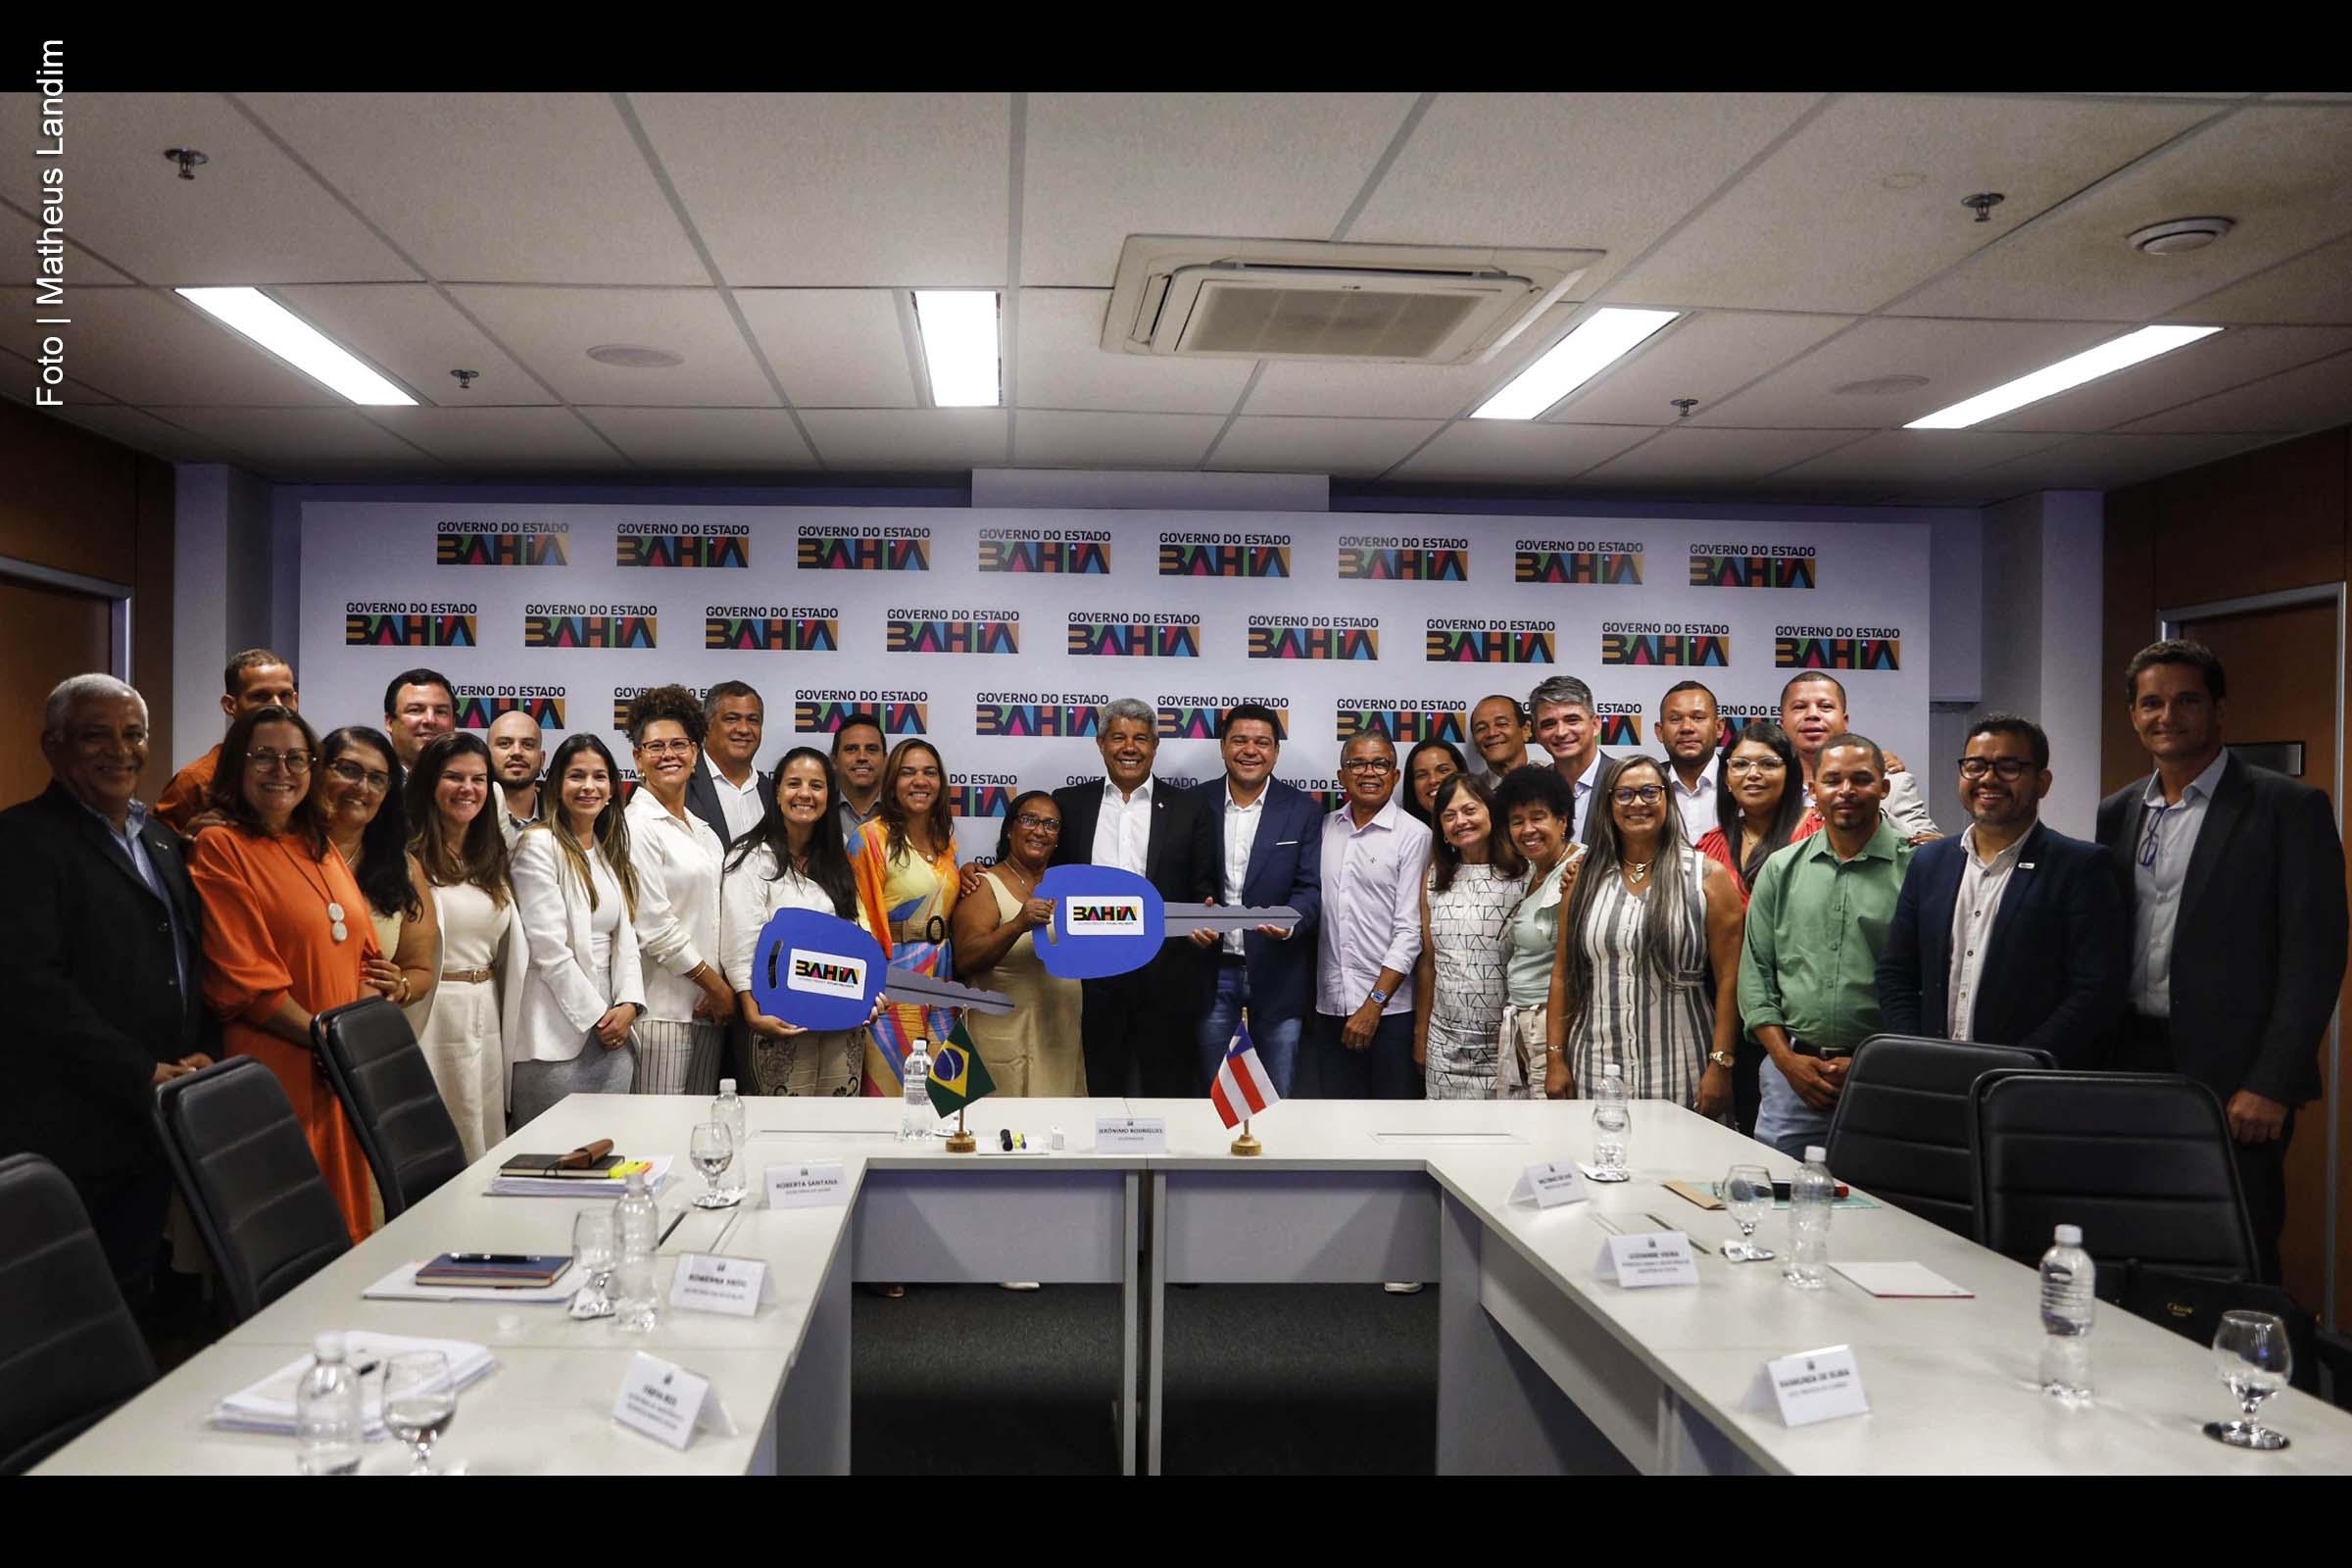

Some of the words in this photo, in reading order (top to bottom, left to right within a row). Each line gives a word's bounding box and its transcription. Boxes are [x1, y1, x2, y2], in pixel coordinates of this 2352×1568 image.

[437, 522, 498, 533] GOVERNO
[502, 523, 519, 533] DO
[523, 523, 569, 534] ESTADO
[617, 523, 678, 534] GOVERNO
[682, 524, 699, 534] DO
[704, 525, 749, 536] ESTADO
[798, 526, 858, 537] GOVERNO
[862, 527, 880, 538] DO
[884, 527, 930, 538] ESTADO
[980, 529, 1040, 540] GOVERNO
[1044, 530, 1061, 540] DO
[1065, 530, 1111, 541] ESTADO
[1160, 533, 1220, 544] GOVERNO
[1223, 534, 1241, 545] DO
[1245, 534, 1291, 545] ESTADO
[1340, 537, 1398, 548] GOVERNO
[1400, 538, 1419, 549] DO
[1423, 538, 1468, 549] ESTADO
[1516, 541, 1574, 552] GOVERNO
[1579, 541, 1595, 552] DO
[1599, 542, 1643, 553] ESTADO
[1690, 544, 1747, 555] GOVERNO
[1752, 546, 1768, 556] DO
[1772, 546, 1815, 557] ESTADO
[346, 602, 407, 612] GOVERNO
[411, 604, 427, 613] DO
[431, 604, 477, 614] ESTADO
[525, 605, 586, 615] GOVERNO
[590, 605, 607, 615] DO
[612, 605, 658, 615] ESTADO
[706, 606, 767, 616] GOVERNO
[770, 608, 788, 617] DO
[792, 608, 838, 618] ESTADO
[887, 609, 948, 619] GOVERNO
[953, 611, 969, 620] DO
[973, 611, 1019, 621] ESTADO
[1068, 612, 1129, 623] GOVERNO
[1134, 613, 1151, 623] DO
[1154, 613, 1200, 624] ESTADO
[1249, 615, 1308, 626] GOVERNO
[1312, 616, 1329, 627] DO
[1333, 617, 1379, 628] ESTADO
[1427, 619, 1487, 630] GOVERNO
[1489, 620, 1506, 631] DO
[1510, 619, 1555, 630] ESTADO
[1602, 622, 1661, 633] GOVERNO
[1665, 623, 1682, 634] DO
[1685, 624, 1729, 635] ESTADO
[1776, 626, 1836, 637] GOVERNO
[1837, 627, 1853, 637] DO
[1856, 628, 1900, 639] ESTADO
[452, 686, 494, 697] VERNO
[498, 686, 515, 697] DO
[519, 687, 565, 697] ESTADO
[796, 690, 857, 701] GOVERNO
[860, 691, 877, 701] DO
[882, 691, 928, 702] ESTADO
[977, 693, 1038, 704] GOVERNO
[1042, 694, 1058, 705] DO
[1062, 694, 1109, 705] ESTADO
[1157, 696, 1218, 707] GOVERNO
[1222, 697, 1239, 707] DO
[1337, 699, 1396, 710] GOVERNO
[1400, 700, 1417, 710] DO
[1421, 700, 1467, 710] ESTADO
[1597, 703, 1642, 713] ESTADO
[1750, 706, 1767, 715] DO
[950, 774, 967, 784] DO
[971, 774, 1017, 784] ESTADO
[1310, 780, 1327, 789] DO
